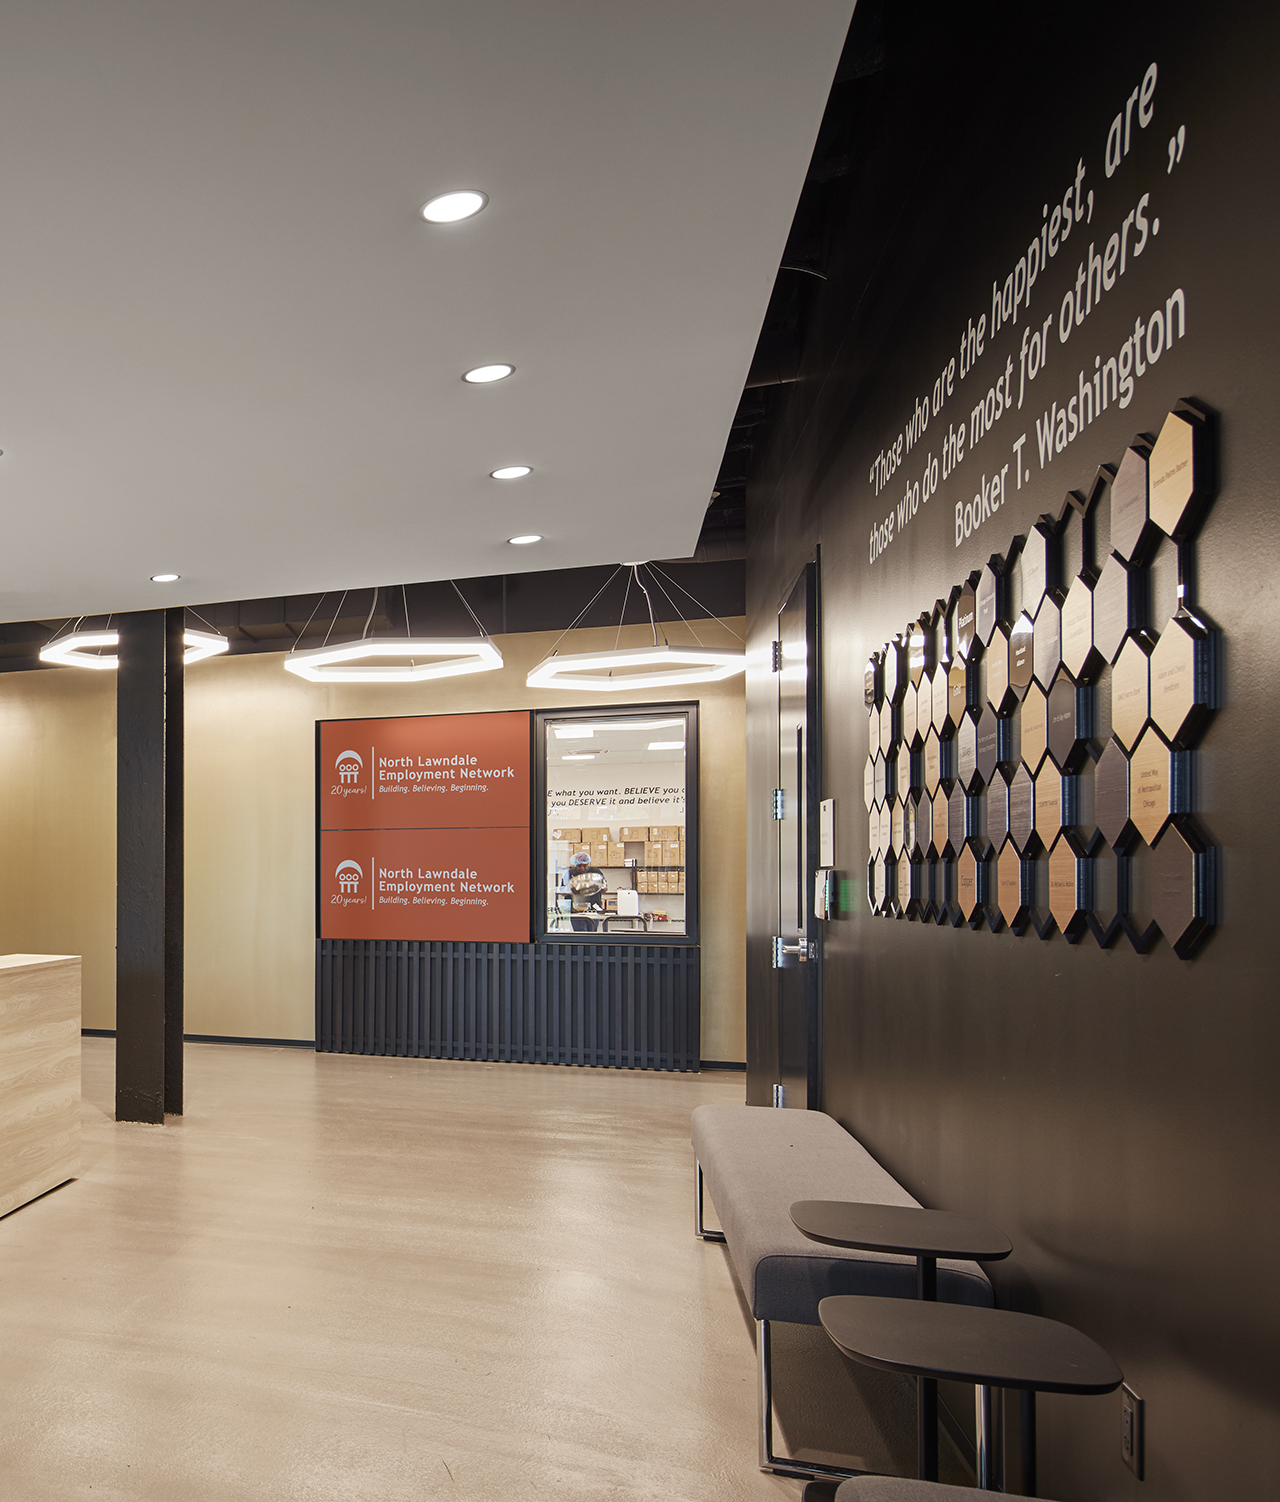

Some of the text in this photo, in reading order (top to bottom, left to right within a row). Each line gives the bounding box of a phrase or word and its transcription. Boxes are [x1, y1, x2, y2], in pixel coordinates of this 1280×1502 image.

[905, 396, 930, 455] who
[932, 357, 956, 418] are
[959, 314, 987, 380] the
[990, 157, 1095, 340] happiest,
[1104, 61, 1158, 179] are
[955, 288, 1186, 548] Booker T. Washington
[869, 511, 895, 565] those
[896, 479, 920, 534] who
[922, 451, 939, 504] do
[942, 423, 967, 481] the
[970, 354, 1014, 450] most
[1017, 313, 1053, 411] for
[379, 754, 478, 768] North Lawndale
[379, 767, 515, 782] Employment Network
[379, 783, 489, 795] Building. Believing. Beginning.
[555, 789, 576, 797] what
[579, 790, 595, 798] you
[597, 788, 621, 796] want.
[624, 786, 661, 795] BELIEVE
[663, 787, 680, 796] you
[551, 800, 567, 808] you
[568, 798, 607, 806] DESERVE
[609, 797, 616, 805] it
[618, 797, 635, 805] and
[637, 796, 670, 805] believe
[379, 868, 478, 880] North Lawndale
[379, 881, 515, 894] Employment Network
[379, 896, 489, 907] Building. Believing. Beginning.
